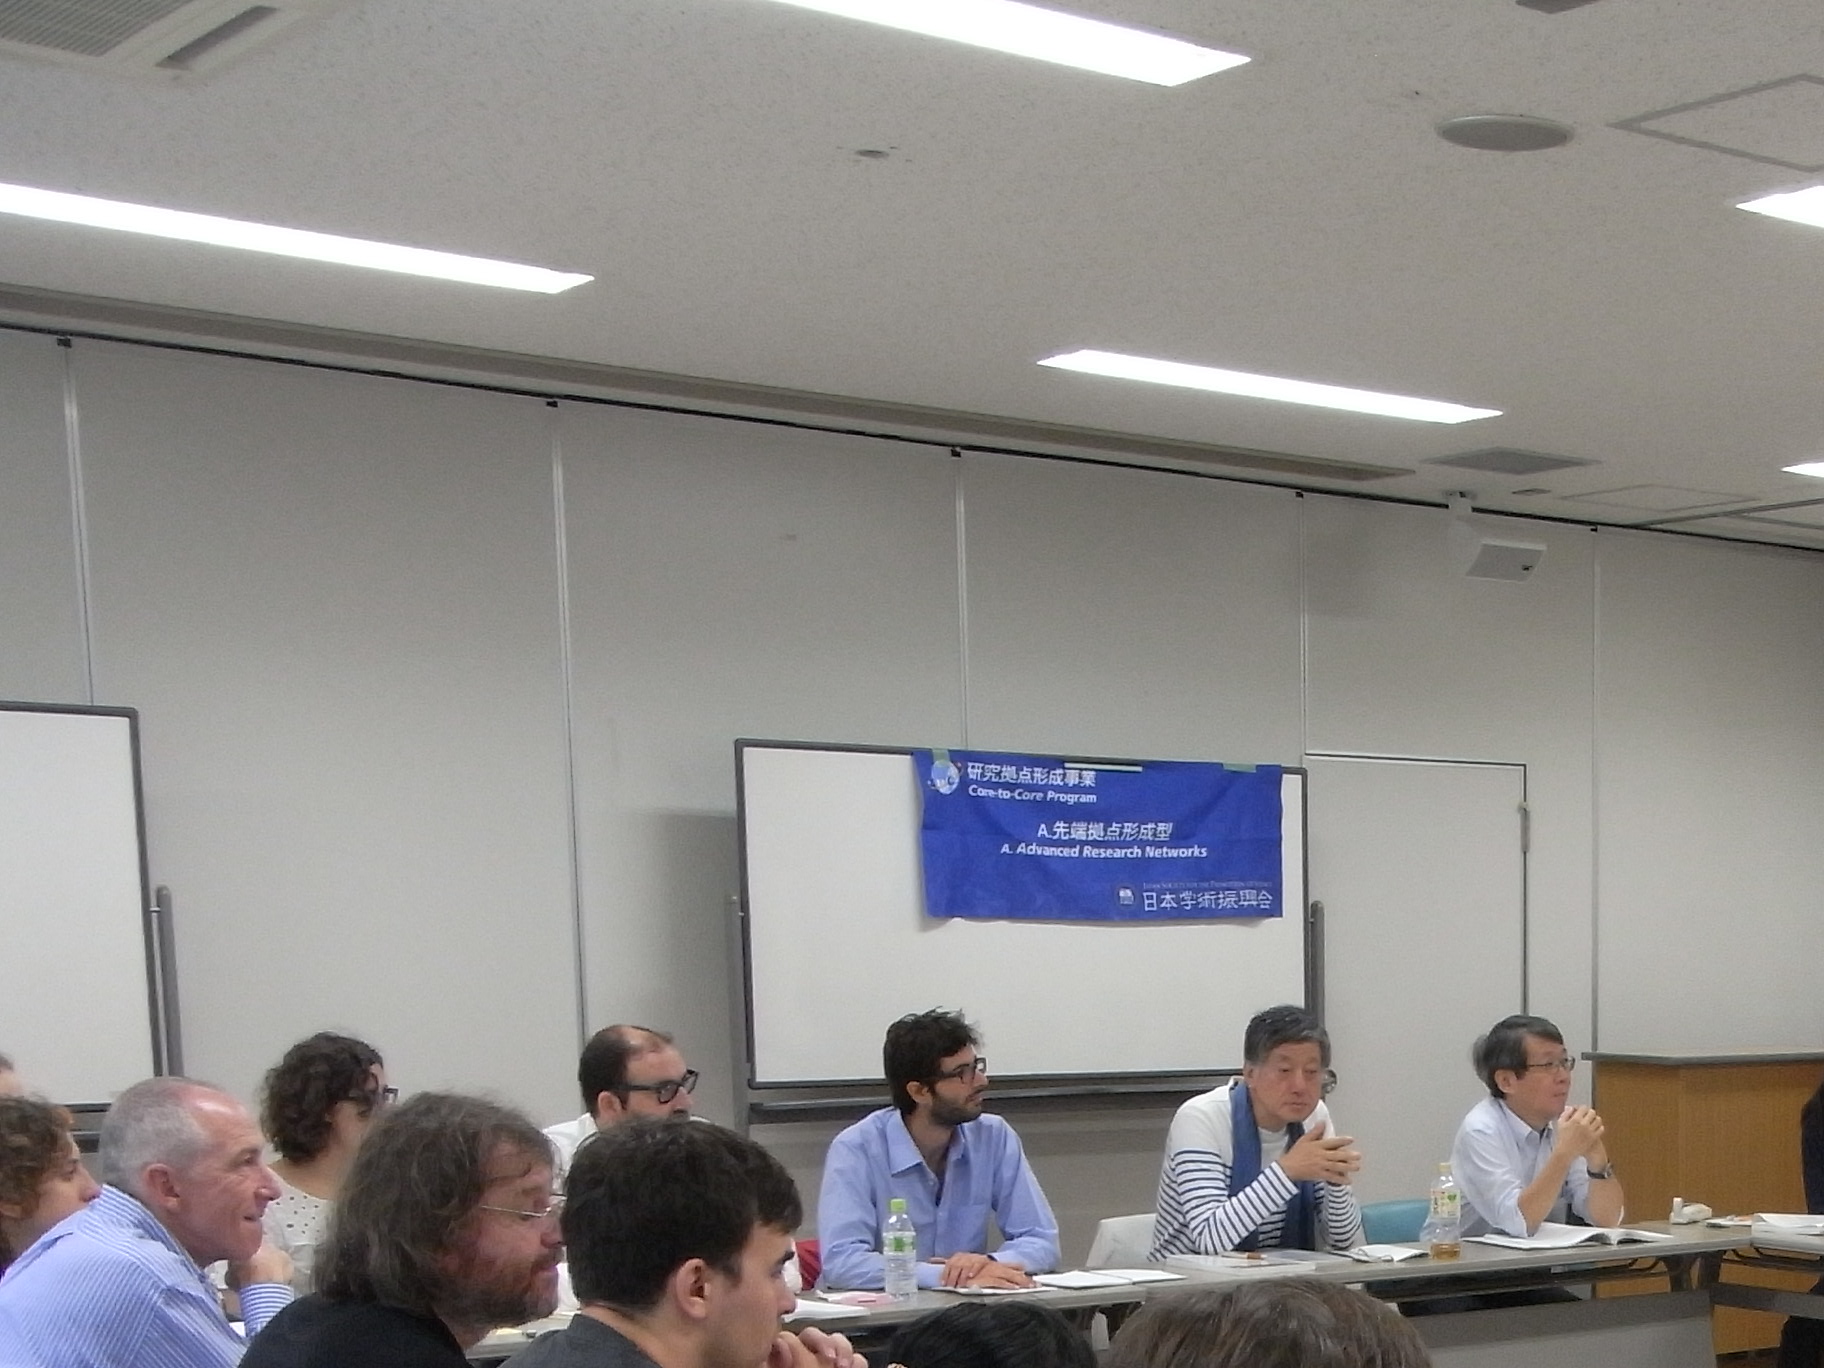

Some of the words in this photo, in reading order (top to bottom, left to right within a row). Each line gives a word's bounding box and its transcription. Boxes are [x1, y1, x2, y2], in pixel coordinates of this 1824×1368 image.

[967, 761, 1097, 788] 研究拠点形成事業
[968, 784, 1044, 801] Core-to-Core
[1047, 791, 1097, 805] Program
[1000, 843, 1014, 855] A.
[1016, 842, 1080, 858] Advanced
[1083, 845, 1142, 858] Research
[1145, 845, 1208, 858] Networks
[1142, 889, 1273, 911] 日本学術振興会
